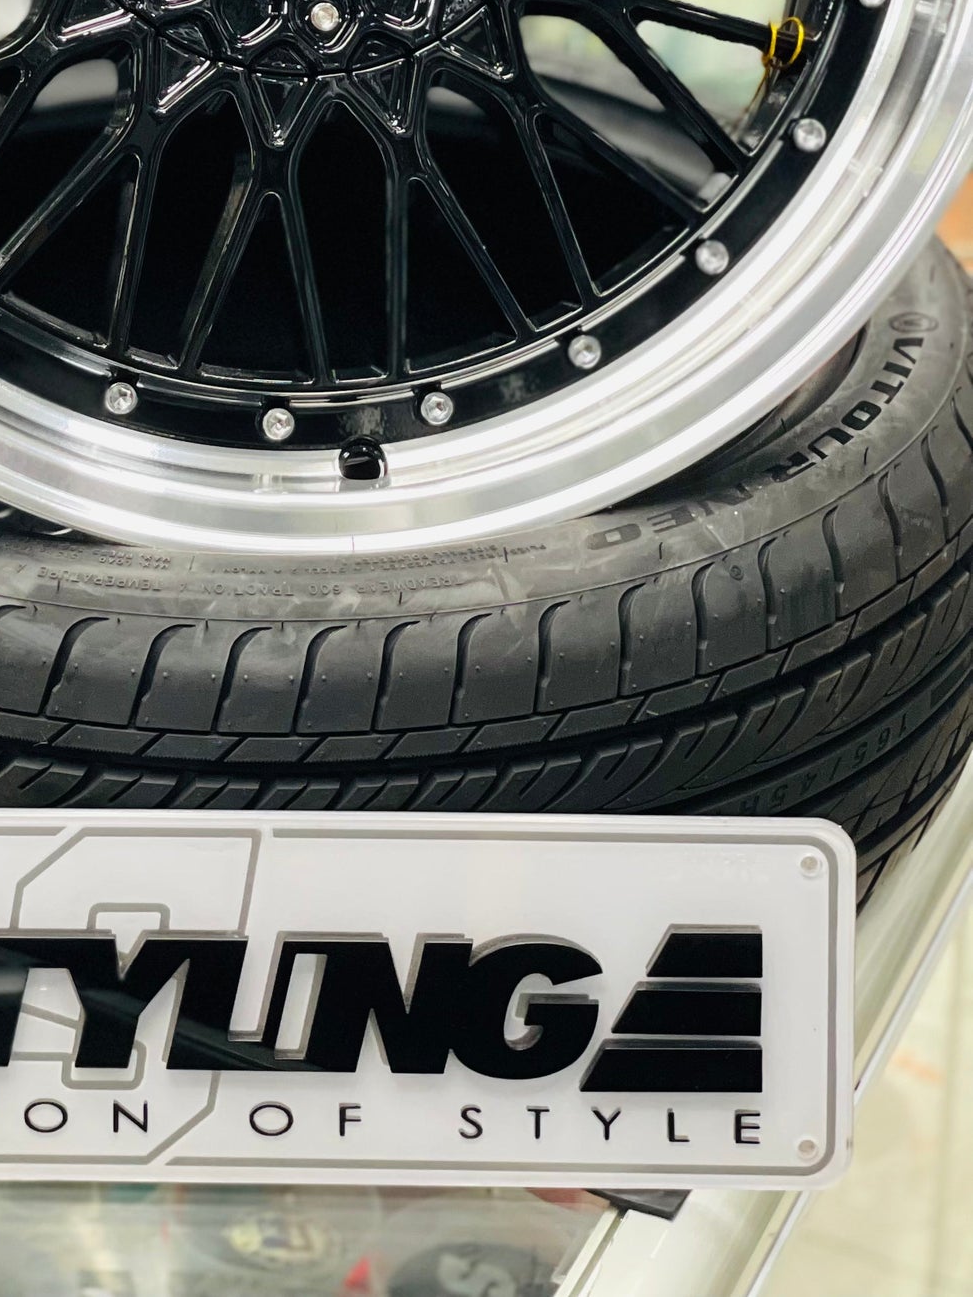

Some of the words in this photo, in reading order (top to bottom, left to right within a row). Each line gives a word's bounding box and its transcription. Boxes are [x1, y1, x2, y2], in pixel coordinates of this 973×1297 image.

[764, 337, 924, 483] VITOUR
[37, 566, 162, 592] TEMPERATURE
[354, 575, 461, 596] TREADWEAR
[250, 1102, 363, 1138] OF
[460, 1103, 763, 1145] STYLE
